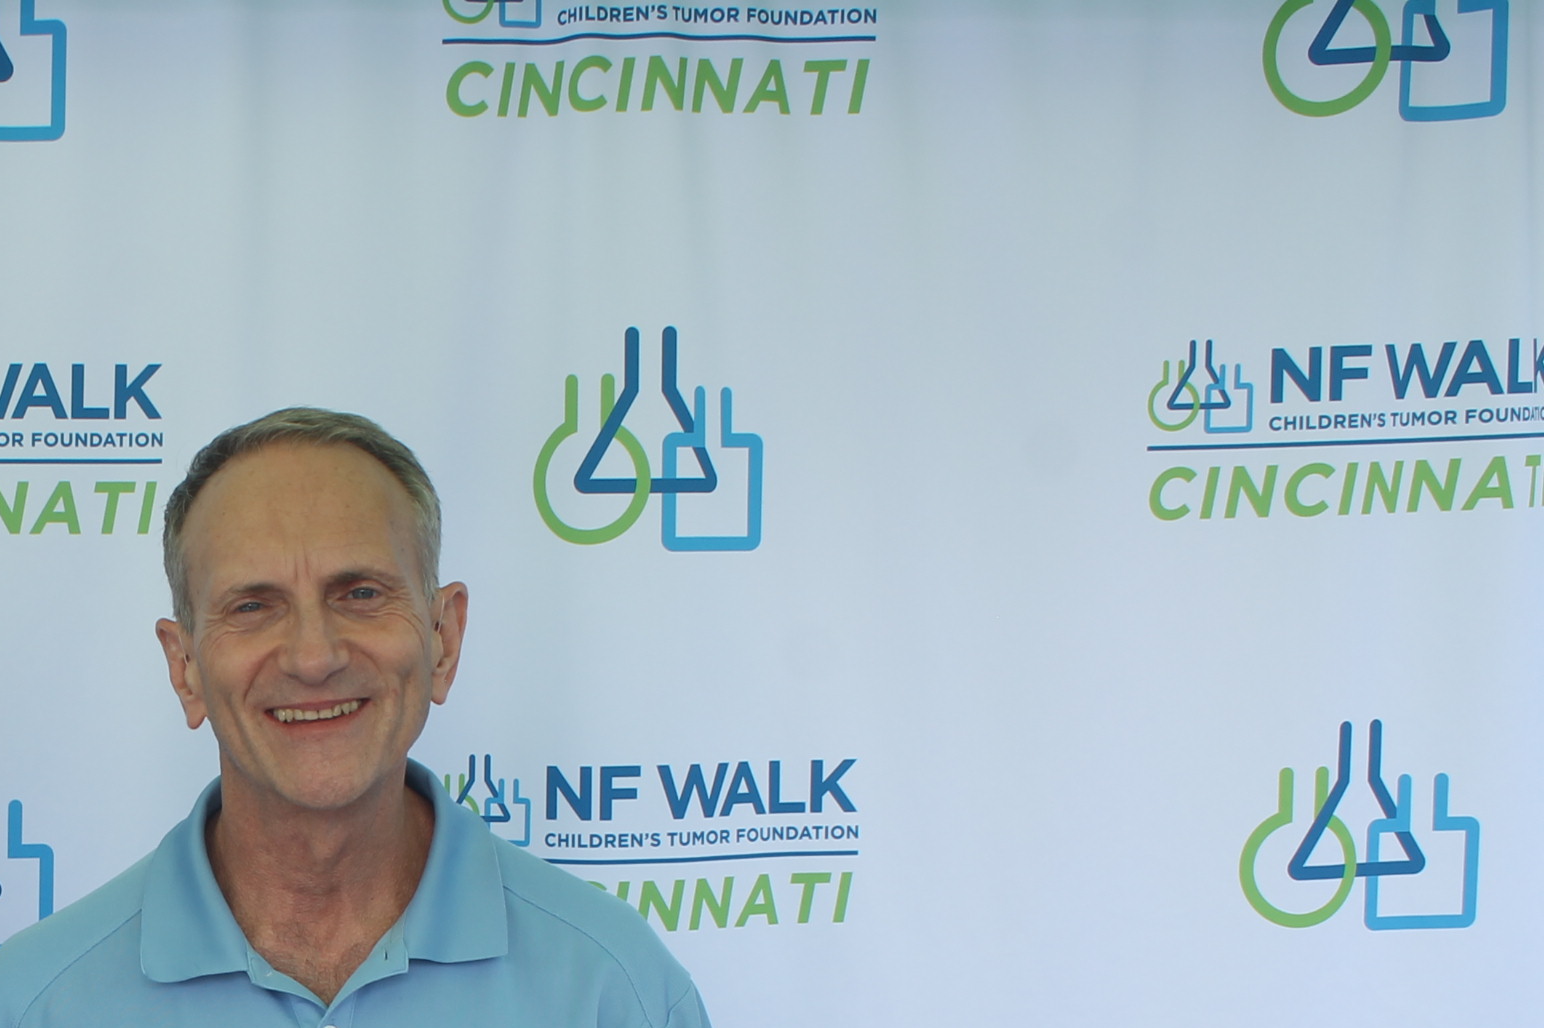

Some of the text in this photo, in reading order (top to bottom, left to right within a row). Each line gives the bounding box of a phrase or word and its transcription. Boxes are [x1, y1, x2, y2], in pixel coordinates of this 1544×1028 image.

[557, 5, 878, 26] CHILDREN'S TUMOR FOUNDATION
[446, 55, 871, 117] CINCINNATI
[1270, 344, 1372, 404] NF
[31, 431, 164, 448] FOUNDATION
[1268, 412, 1386, 431] CHILDREN'S
[1390, 409, 1457, 428] TUMOR
[1148, 454, 1544, 521] CINCINNAT
[545, 758, 858, 821] NF WALK
[545, 825, 859, 849] CHILDREN'S TUMOR FOUNDATION
